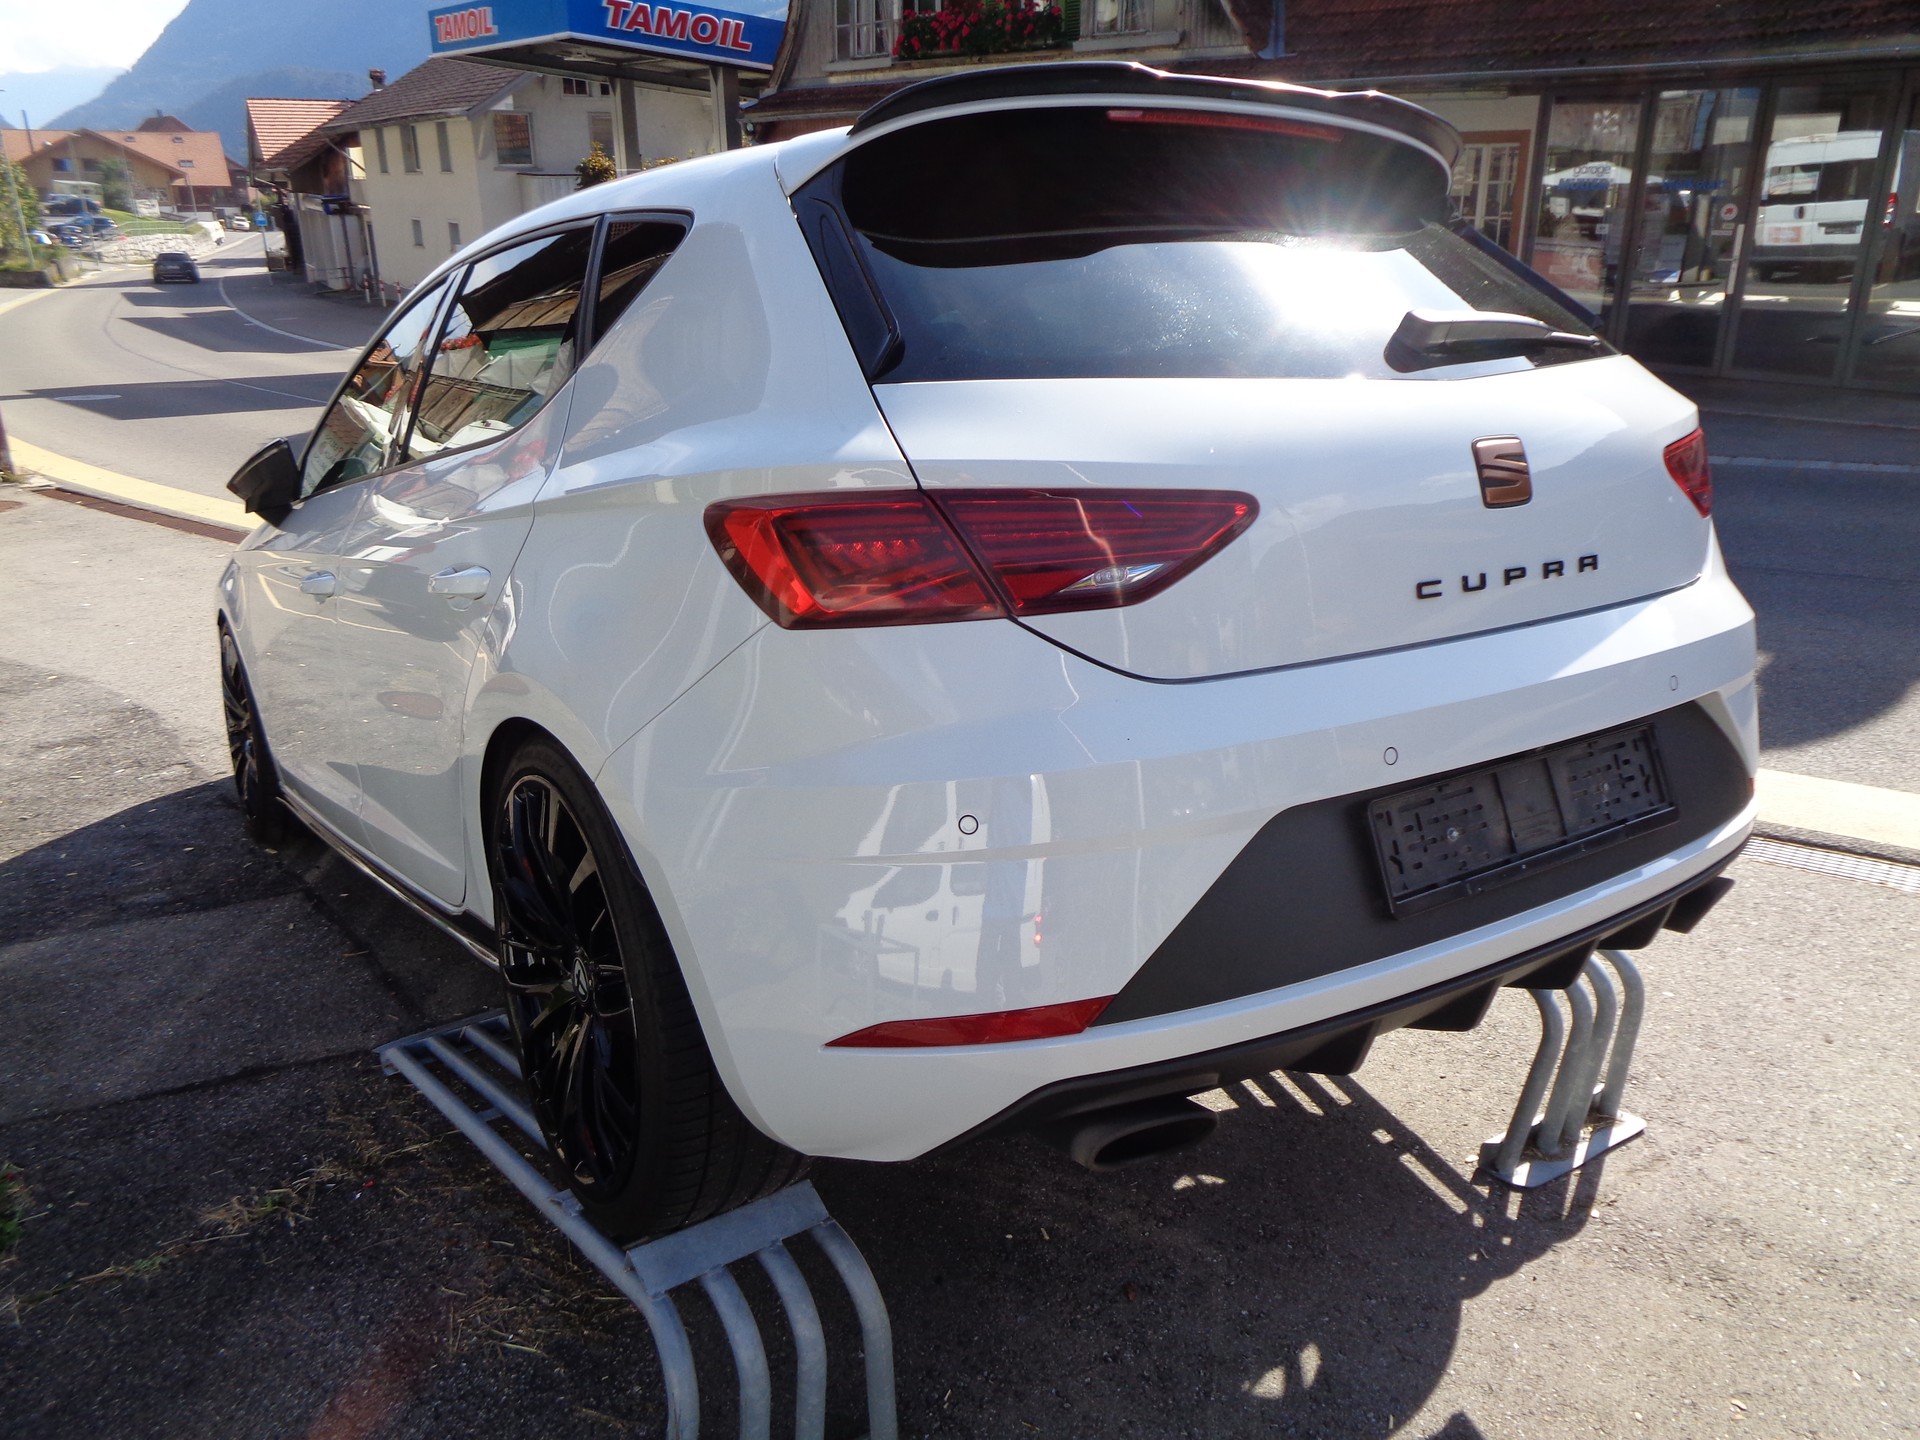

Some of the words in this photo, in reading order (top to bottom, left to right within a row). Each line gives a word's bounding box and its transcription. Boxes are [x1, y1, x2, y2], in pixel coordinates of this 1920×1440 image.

[434, 6, 498, 43] TAMOIL
[602, 0, 752, 52] TAMOIL
[1415, 554, 1599, 600] CUPRA
